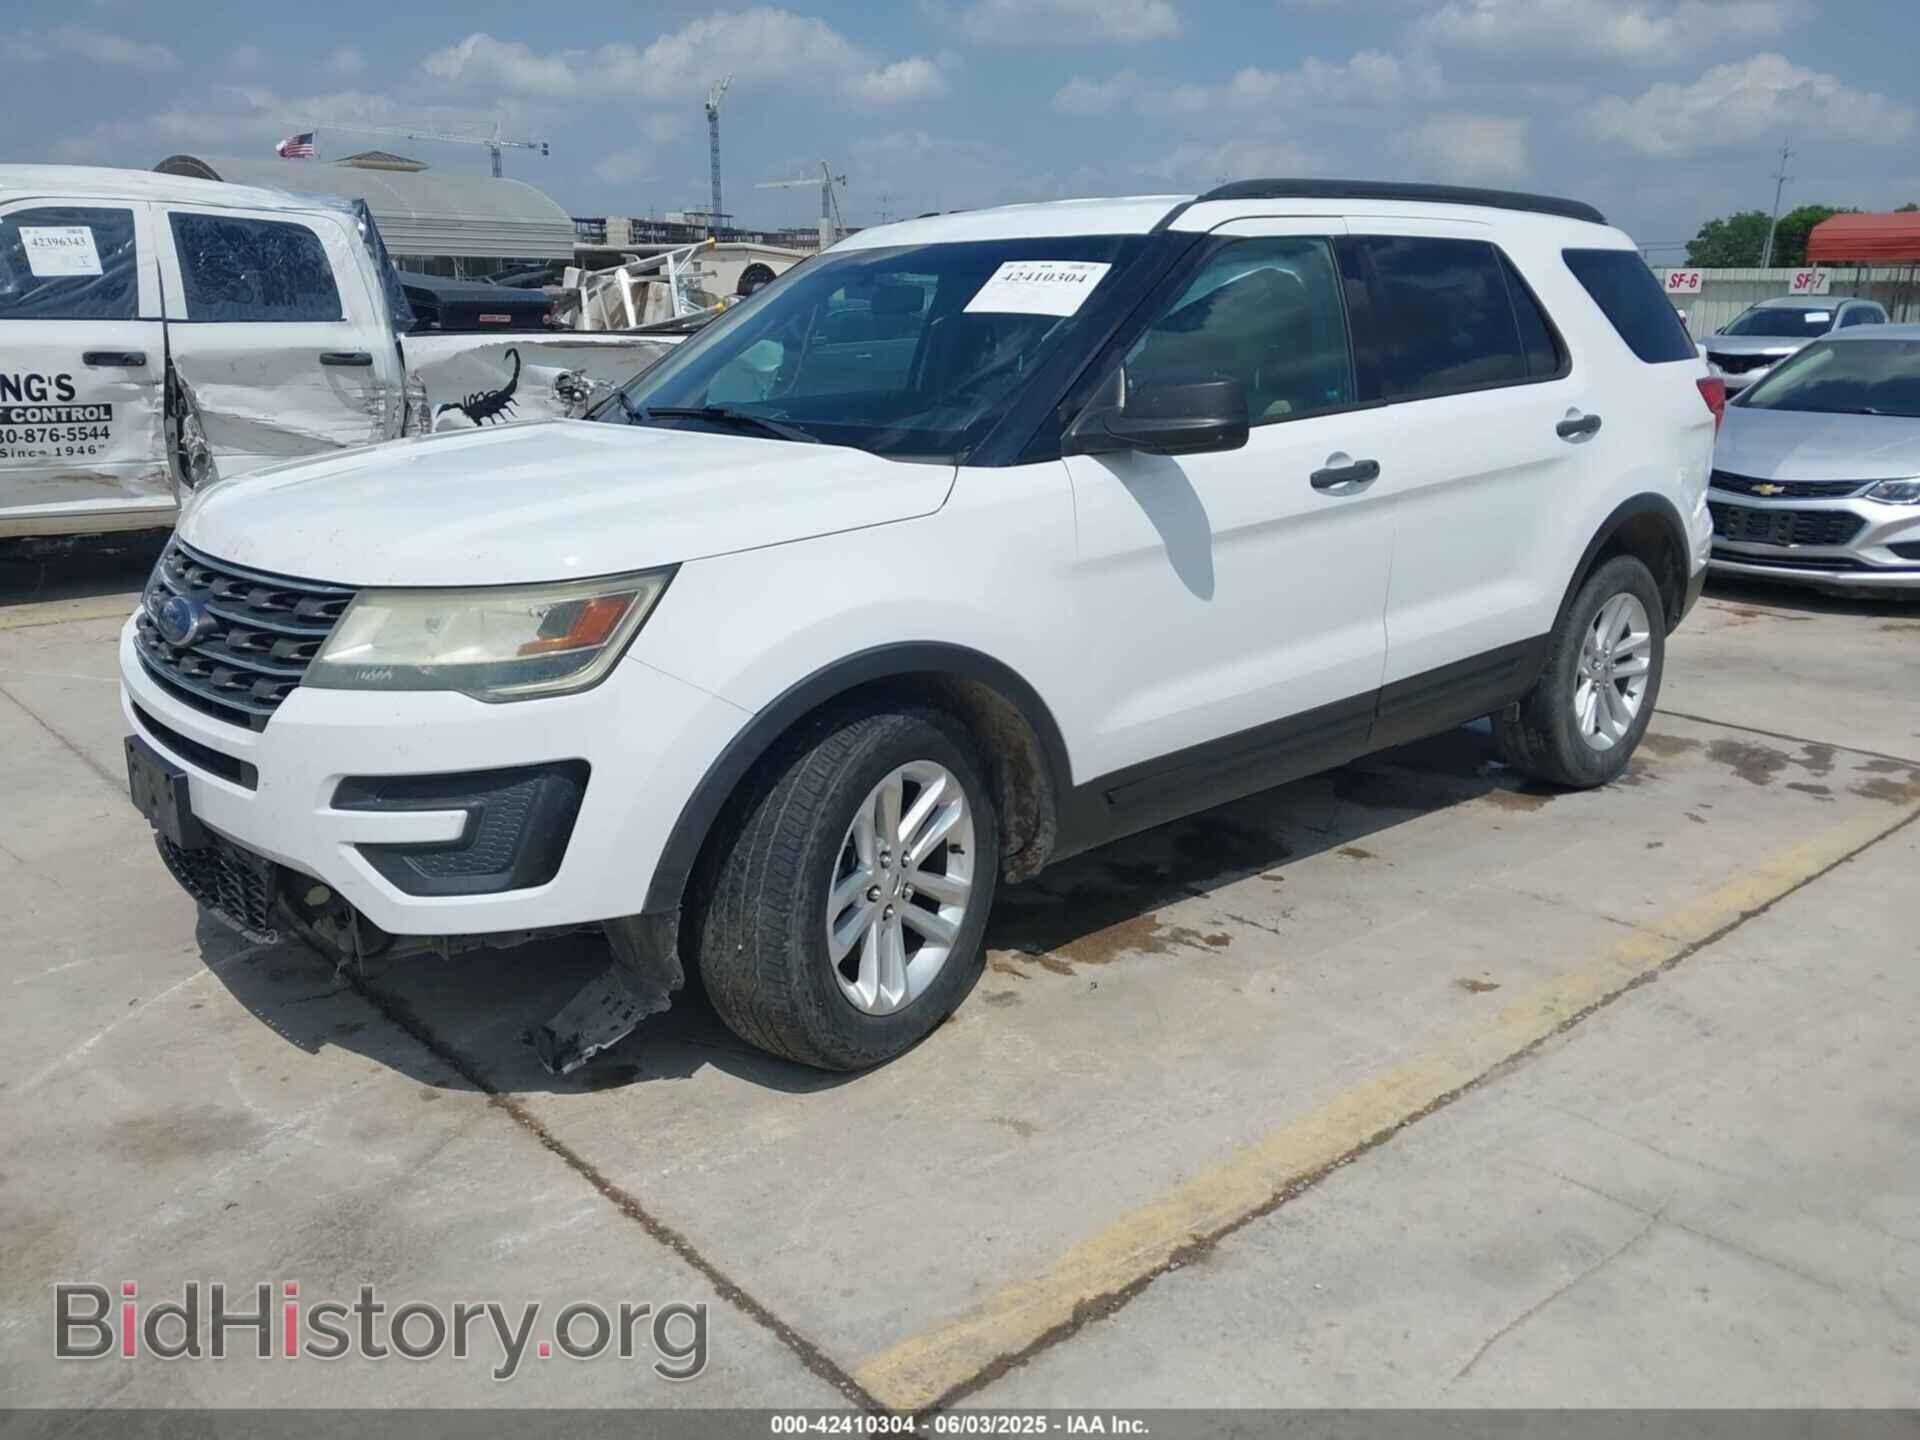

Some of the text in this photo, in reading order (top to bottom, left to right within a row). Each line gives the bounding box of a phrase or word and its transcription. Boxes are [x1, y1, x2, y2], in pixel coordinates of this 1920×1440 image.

[1669, 273, 1698, 288] SF-6
[1795, 273, 1826, 289] SF-7
[10, 406, 110, 422] CONTROL
